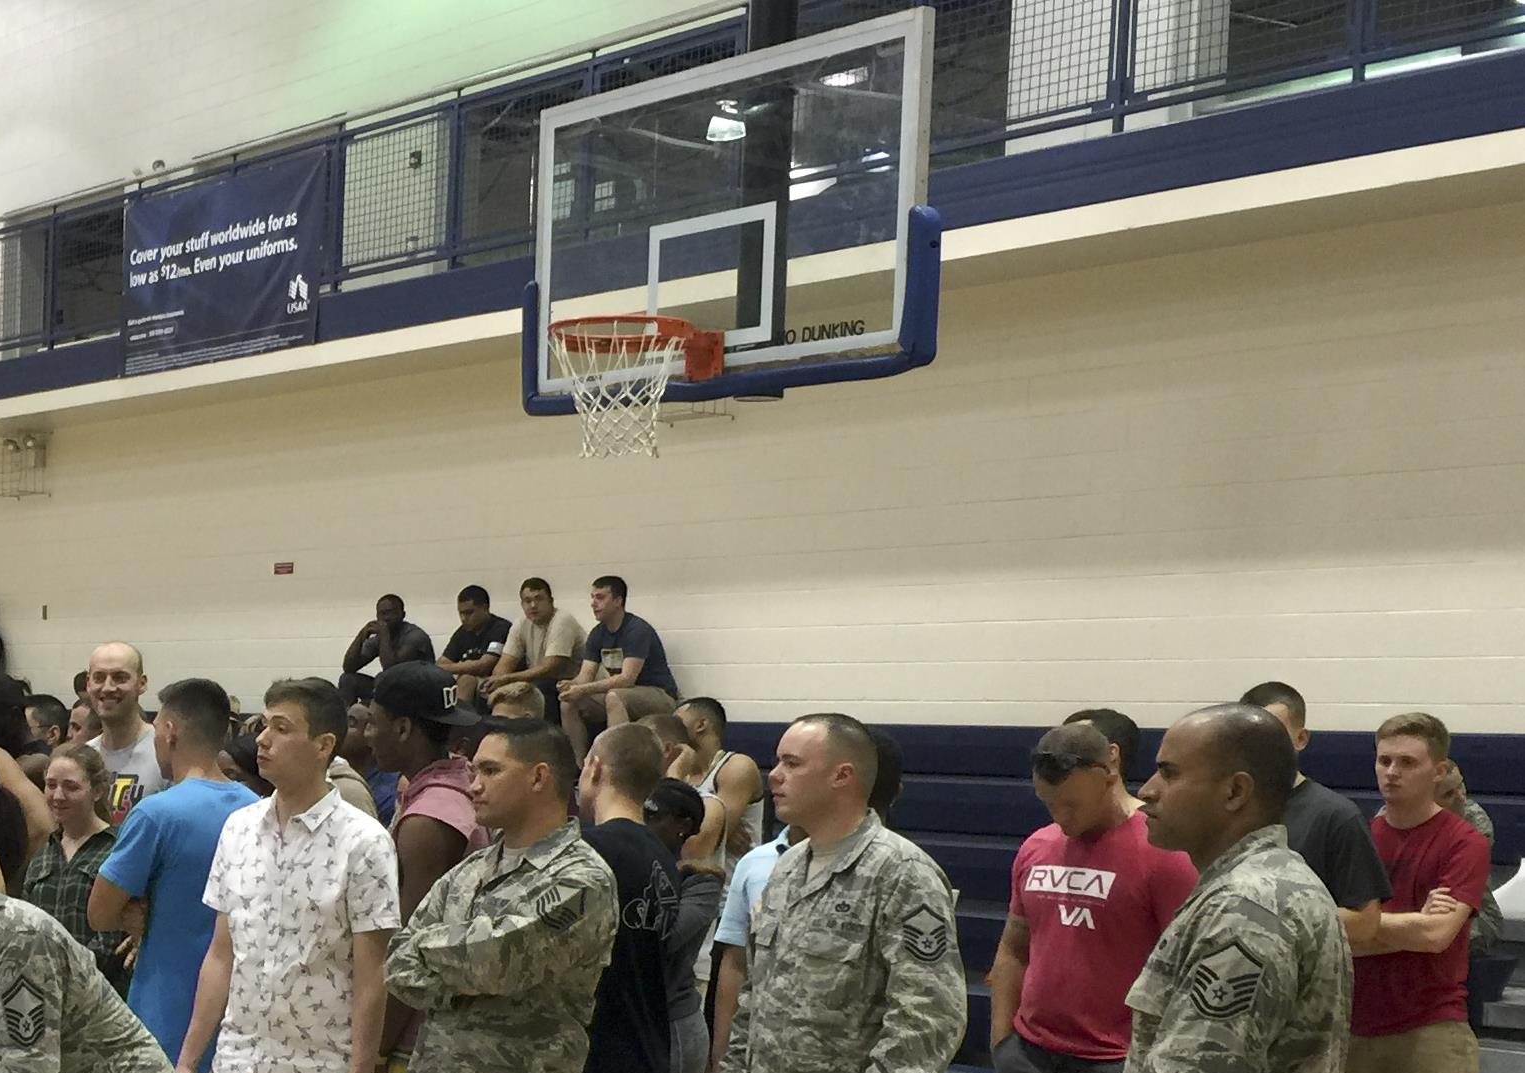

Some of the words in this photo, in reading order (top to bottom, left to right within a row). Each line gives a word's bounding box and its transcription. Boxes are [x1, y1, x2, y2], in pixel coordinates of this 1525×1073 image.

[130, 248, 159, 266] Cover
[160, 242, 184, 264] your
[185, 230, 210, 253] stuff
[210, 218, 266, 247] worldwide
[268, 213, 284, 233] for
[285, 211, 298, 228] as
[129, 271, 148, 289] low
[148, 269, 159, 285] as
[194, 256, 217, 275] Even
[218, 250, 244, 272] your
[246, 237, 298, 262] uniforms.
[287, 300, 308, 315] USAA
[802, 319, 865, 343] DUNKING
[1028, 868, 1105, 894] RVCA
[1058, 904, 1096, 930] VA
